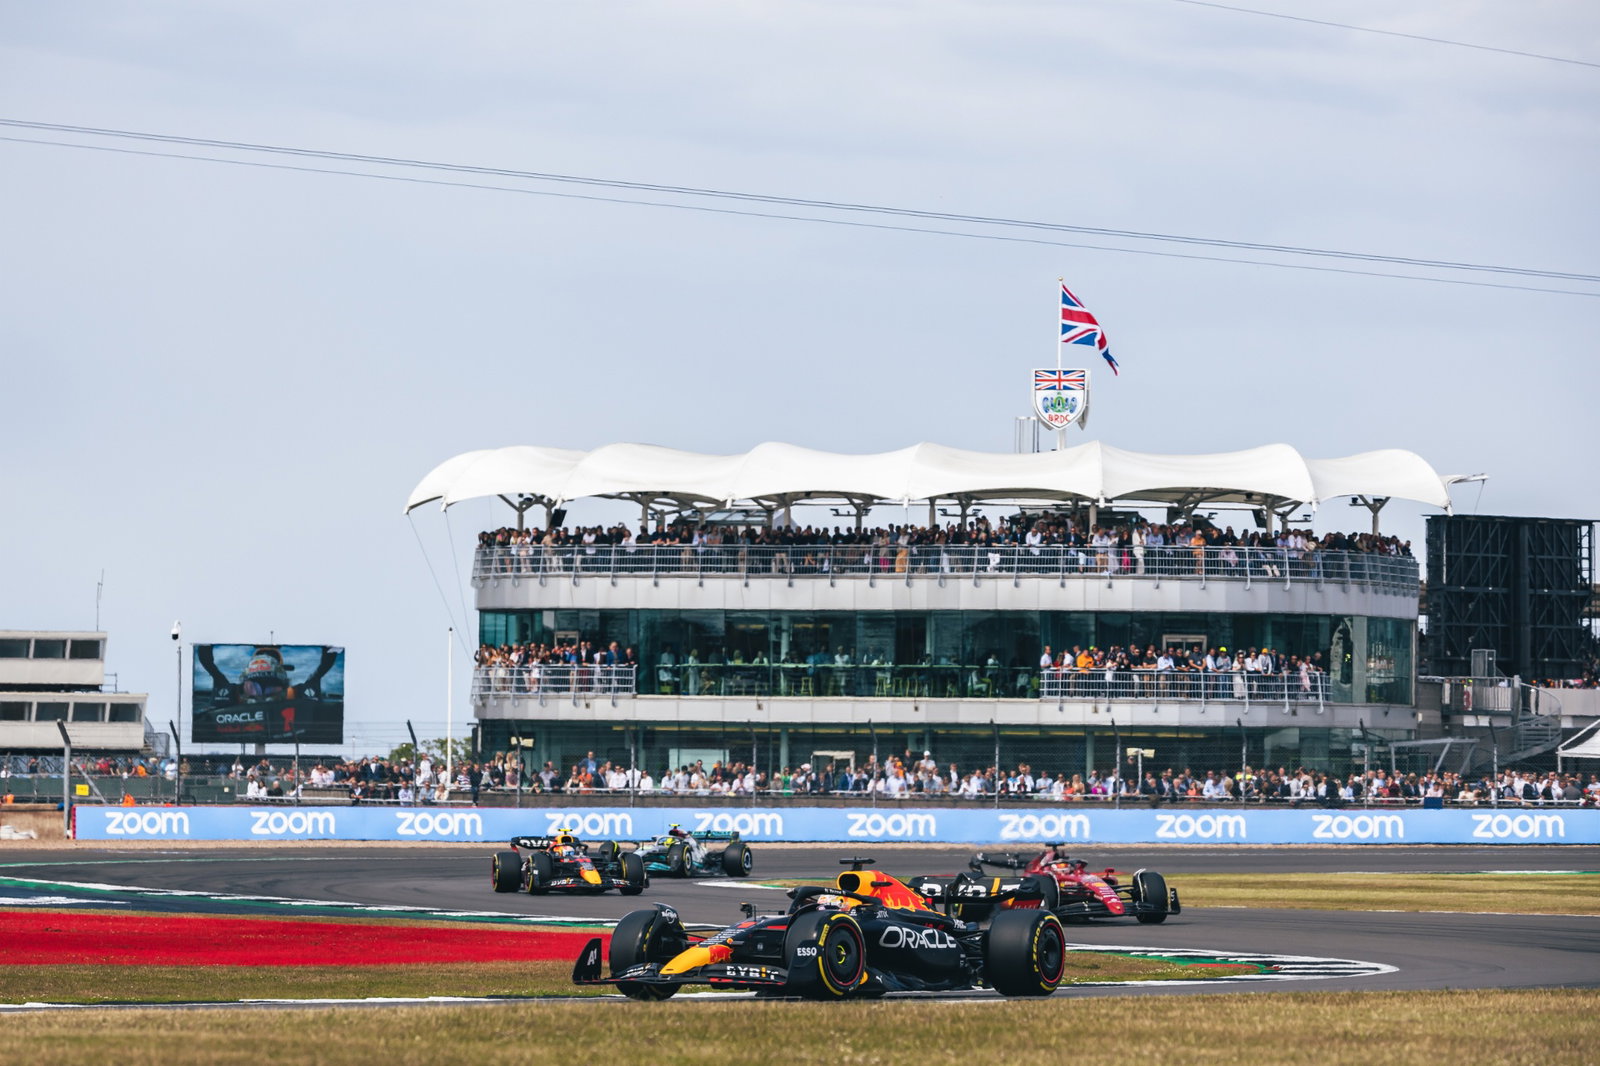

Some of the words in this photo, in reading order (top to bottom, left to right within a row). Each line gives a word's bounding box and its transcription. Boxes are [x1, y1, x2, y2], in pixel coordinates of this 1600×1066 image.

[1048, 414, 1071, 424] BRDC
[216, 711, 264, 724] ORACLE
[281, 707, 296, 732] 1
[105, 811, 190, 835] zoom
[250, 811, 336, 835] zoom
[395, 811, 483, 836] zoom
[545, 812, 633, 836] zoom
[694, 812, 784, 836] zoom
[846, 812, 937, 837] zoom
[997, 814, 1091, 839] zoom
[1154, 814, 1248, 838] zoom
[1312, 814, 1405, 839] zoom
[1472, 814, 1566, 838] zoom
[879, 926, 957, 949] ORACLE
[587, 948, 598, 966] A1
[797, 947, 817, 957] ESSO
